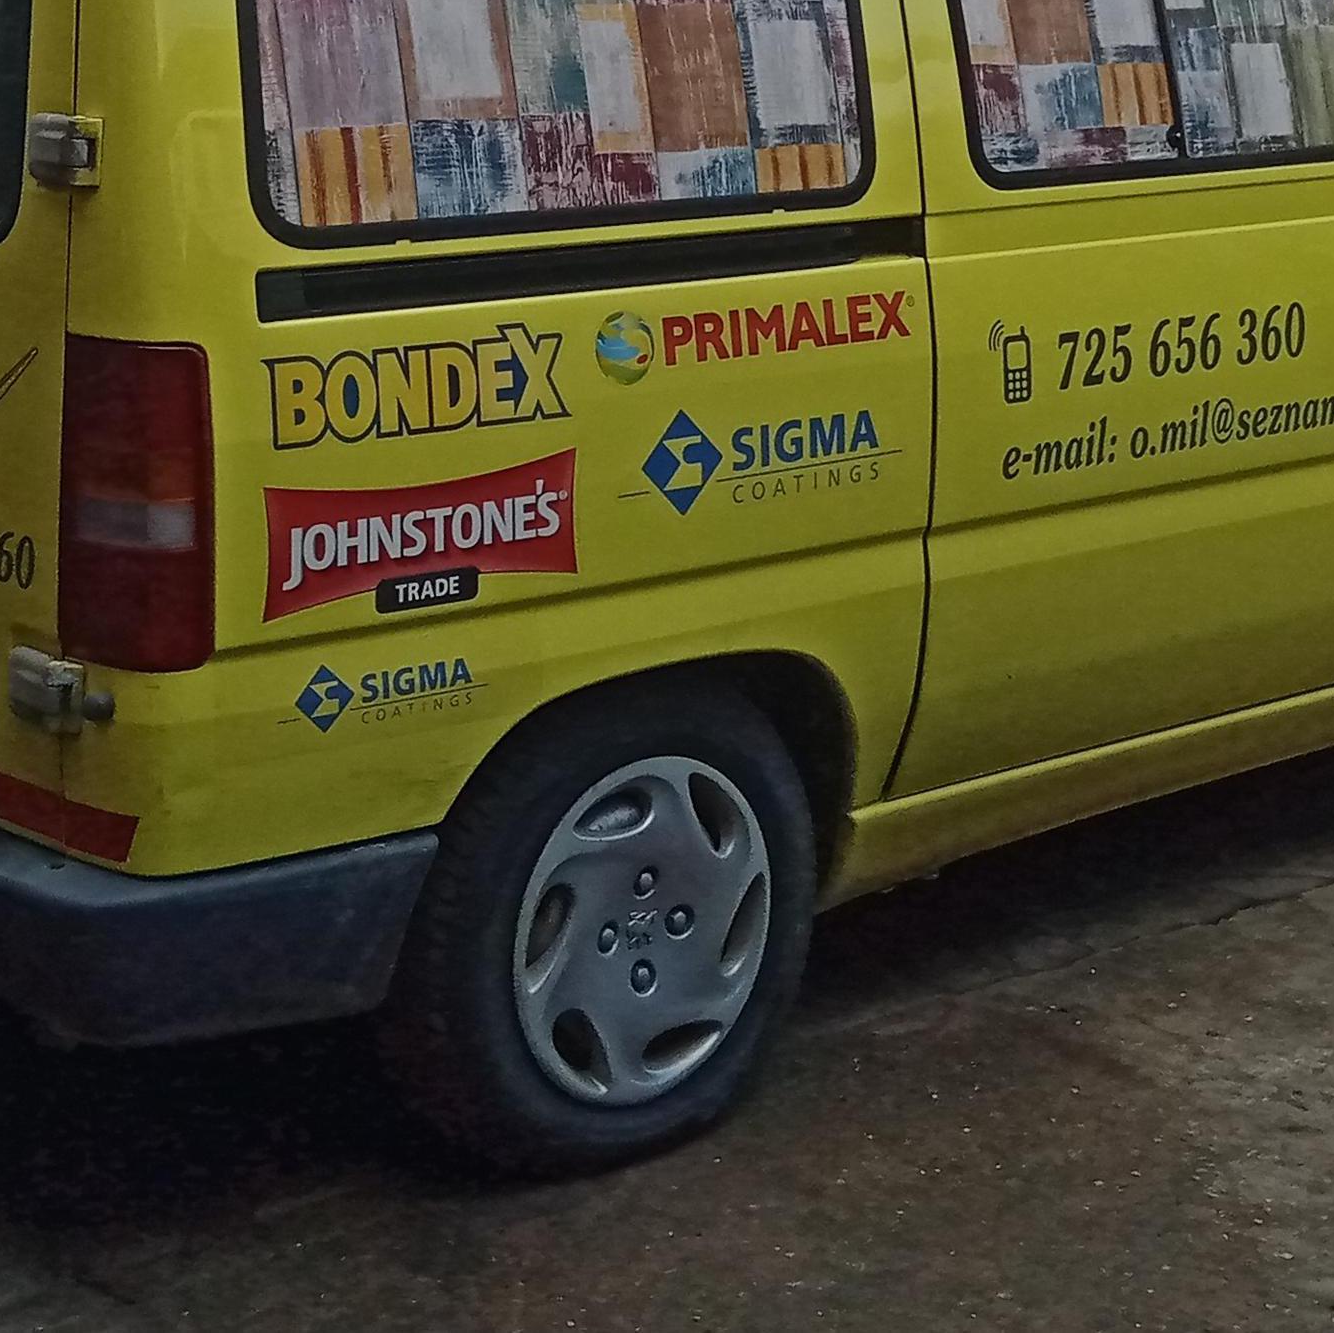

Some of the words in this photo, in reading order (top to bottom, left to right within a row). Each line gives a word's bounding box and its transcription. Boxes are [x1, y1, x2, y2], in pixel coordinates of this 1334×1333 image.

[661, 290, 911, 366] PRIMALEX
[1057, 323, 1133, 390] 725
[1149, 312, 1221, 377] 656
[1236, 301, 1305, 366] 360
[260, 322, 572, 450] BONDEX
[731, 409, 880, 472] SIGMA
[1002, 415, 1117, 480] e-mail:
[732, 461, 880, 504] COATINGS
[394, 575, 460, 604] TRADE
[360, 658, 473, 704] SIGMA
[361, 692, 473, 724] COATINGS
